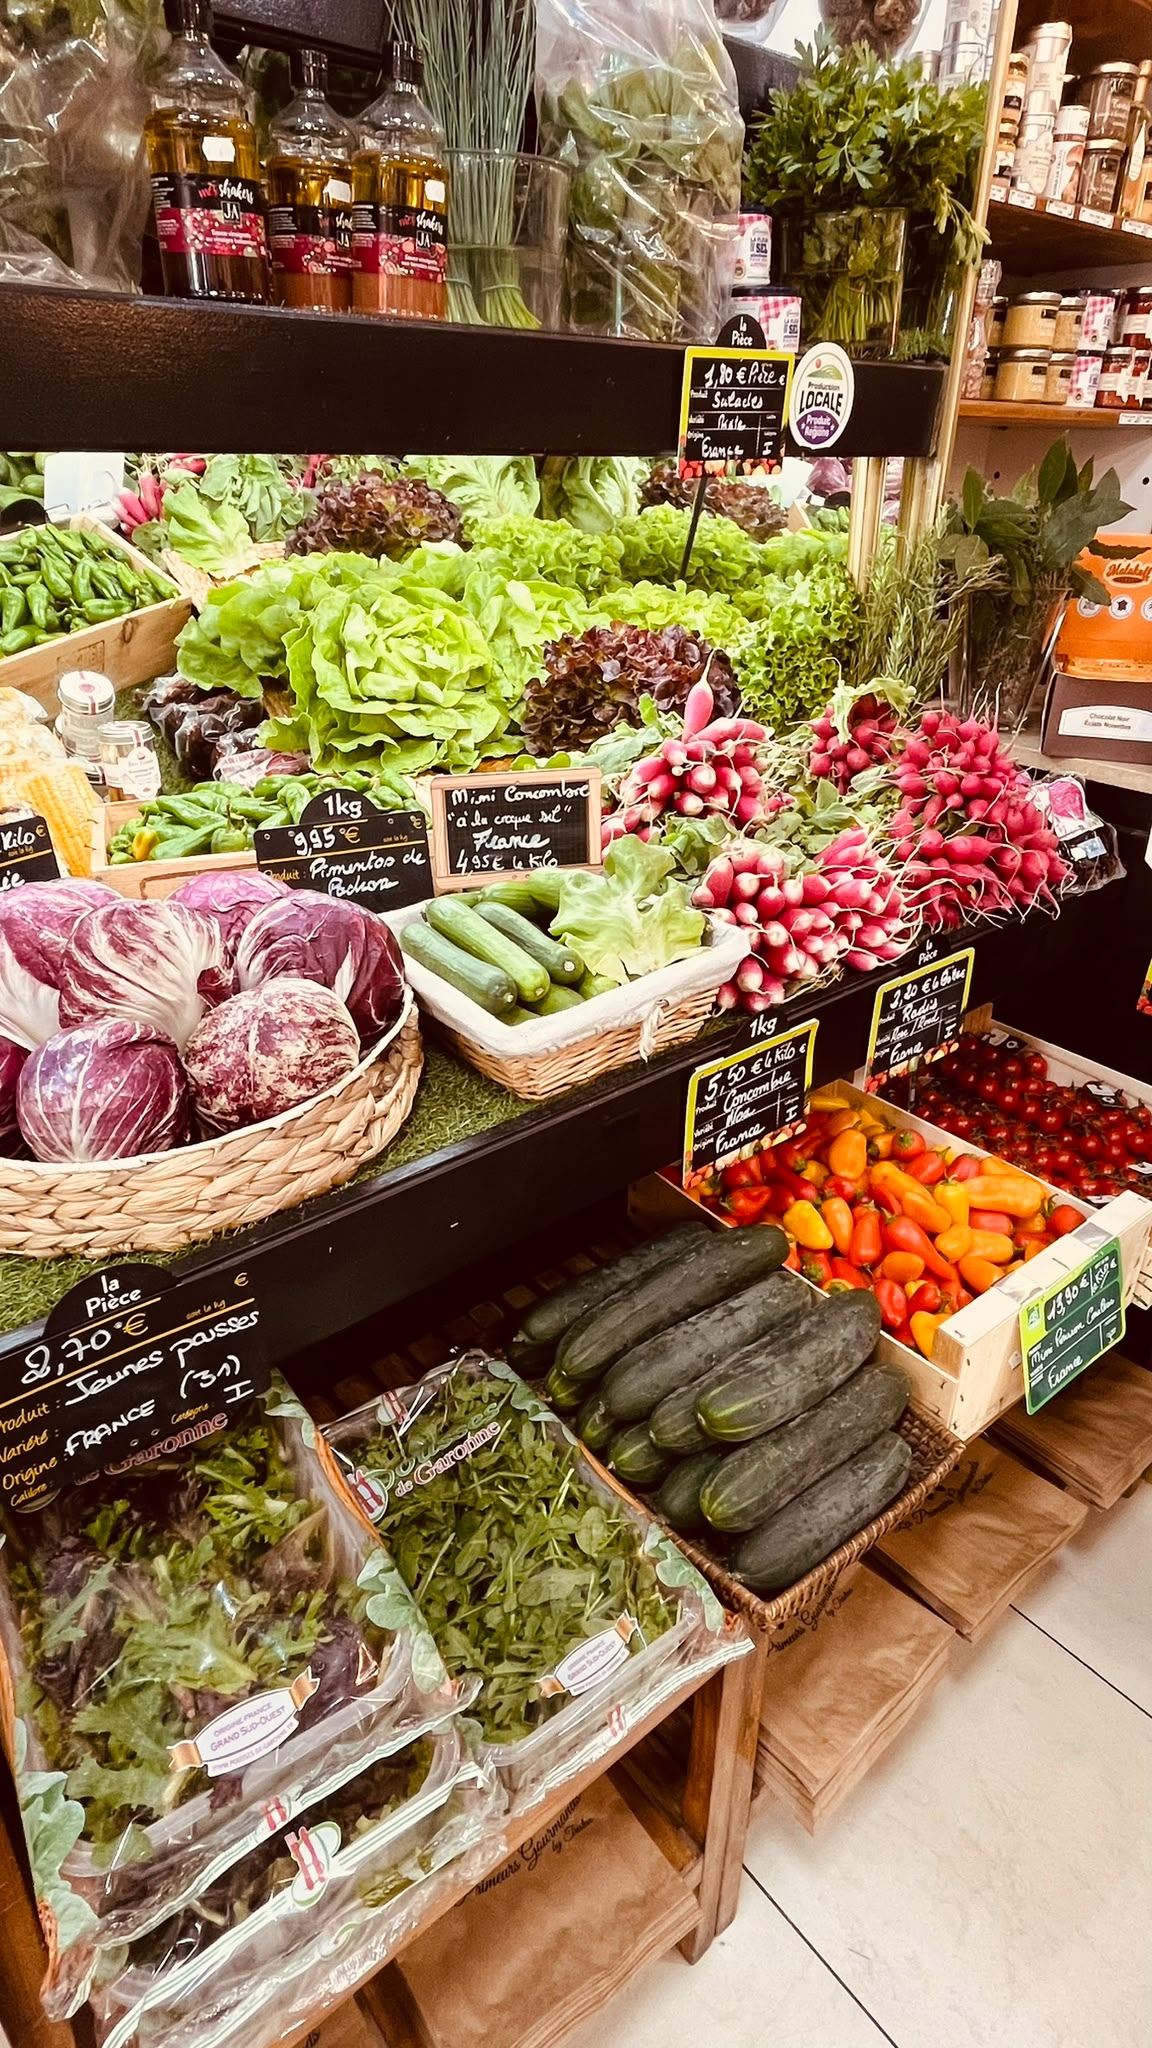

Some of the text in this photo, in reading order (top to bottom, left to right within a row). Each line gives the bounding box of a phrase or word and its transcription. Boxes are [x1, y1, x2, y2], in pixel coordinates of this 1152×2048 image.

[219, 178, 254, 204] shakers
[224, 203, 240, 220] JA
[418, 233, 430, 248] JA
[740, 317, 747, 331] la
[731, 330, 753, 346] Pièce
[808, 381, 840, 390] Production
[712, 391, 763, 409] Salades
[799, 390, 843, 416] LOCALE
[806, 414, 831, 426] Produit
[504, 778, 590, 802] Concombre
[324, 792, 362, 819] 1kg
[494, 813, 533, 830] croque
[472, 827, 550, 851] France
[402, 848, 427, 866] de
[902, 998, 937, 1022] Radis
[750, 1014, 778, 1038] 1kg
[724, 1070, 792, 1113] Concombre
[716, 1123, 765, 1154] France
[100, 1274, 120, 1294] la
[85, 1288, 142, 1318] Pièce
[21, 1272, 249, 1385] 2,70 € €
[1048, 1354, 1083, 1389] France
[0, 1403, 50, 1434] roduit
[64, 1350, 164, 1406] Jeunes
[224, 1380, 254, 1405] I
[2, 1457, 58, 1490] Origine
[64, 1400, 155, 1457] FRANCE
[395, 1421, 502, 1498] de Garonne
[210, 1705, 285, 1751] GRAND SUD-OUEST
[214, 1702, 272, 1737] ORIGINE FRANCE
